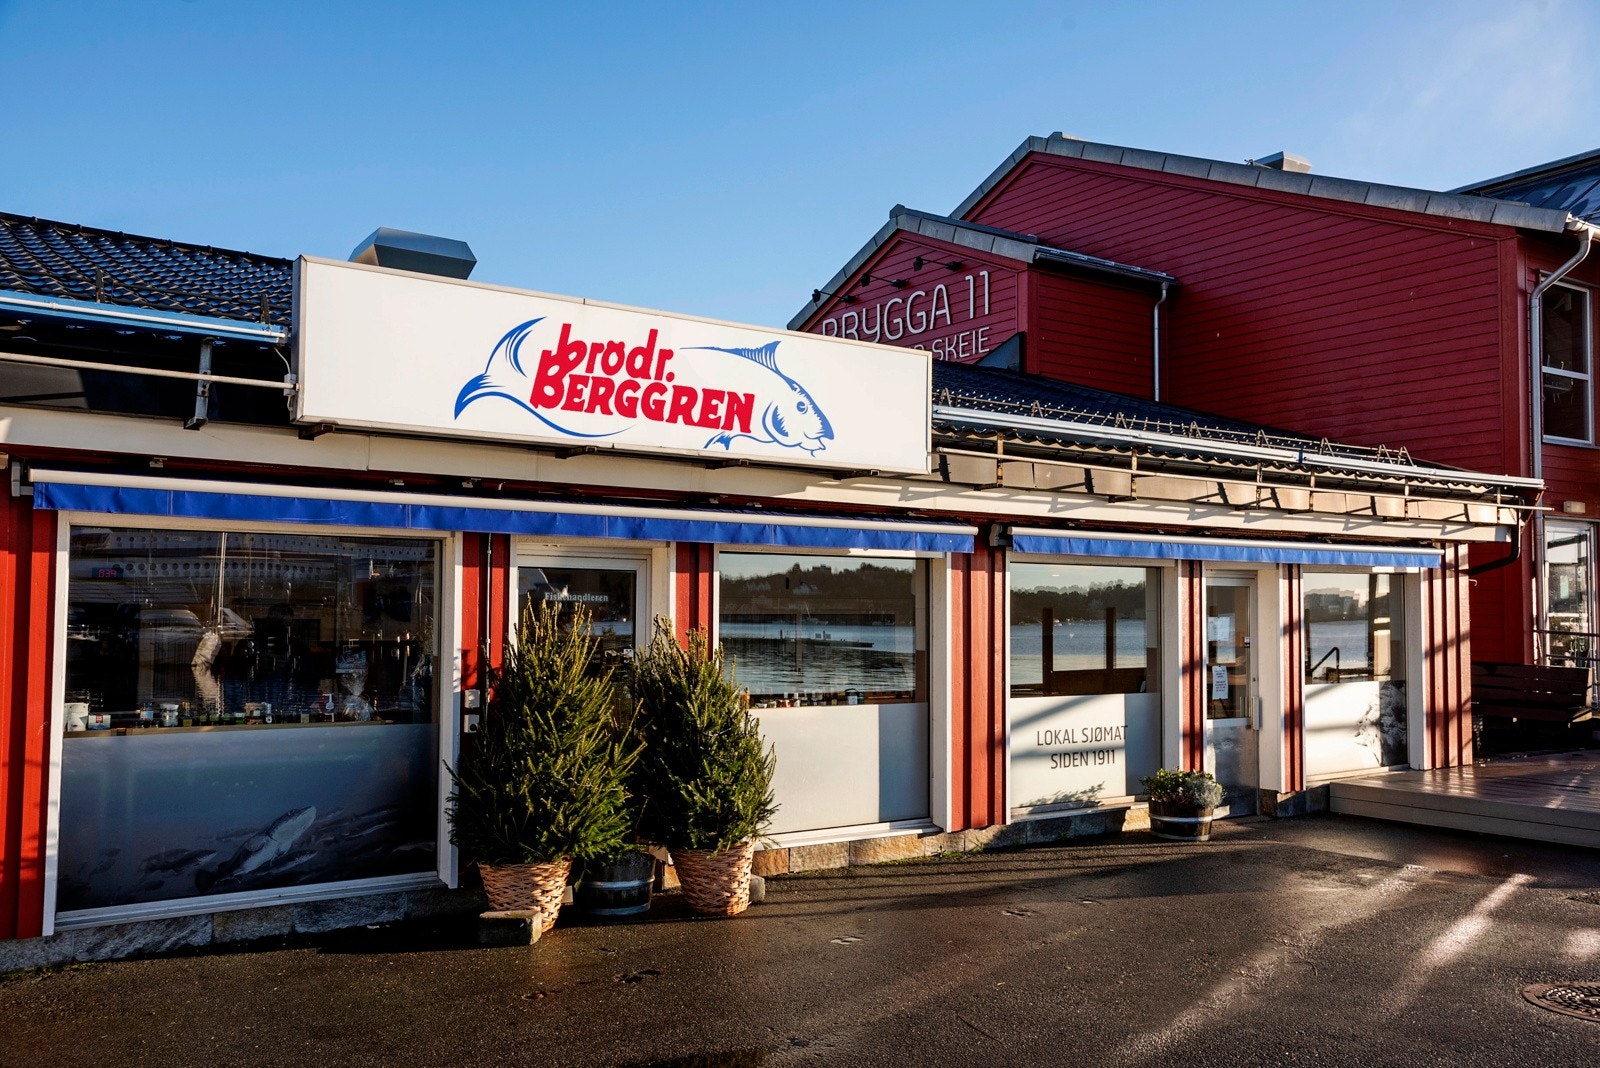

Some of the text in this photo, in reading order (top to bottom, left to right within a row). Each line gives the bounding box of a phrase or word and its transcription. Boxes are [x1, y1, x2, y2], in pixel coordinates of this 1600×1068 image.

[965, 270, 990, 320] 11
[932, 326, 990, 361] SKEIE
[529, 348, 756, 434] BERGGREN
[1037, 725, 1128, 746] LOKAL SJØMAT
[1050, 749, 1115, 769] SIDEN 1911
